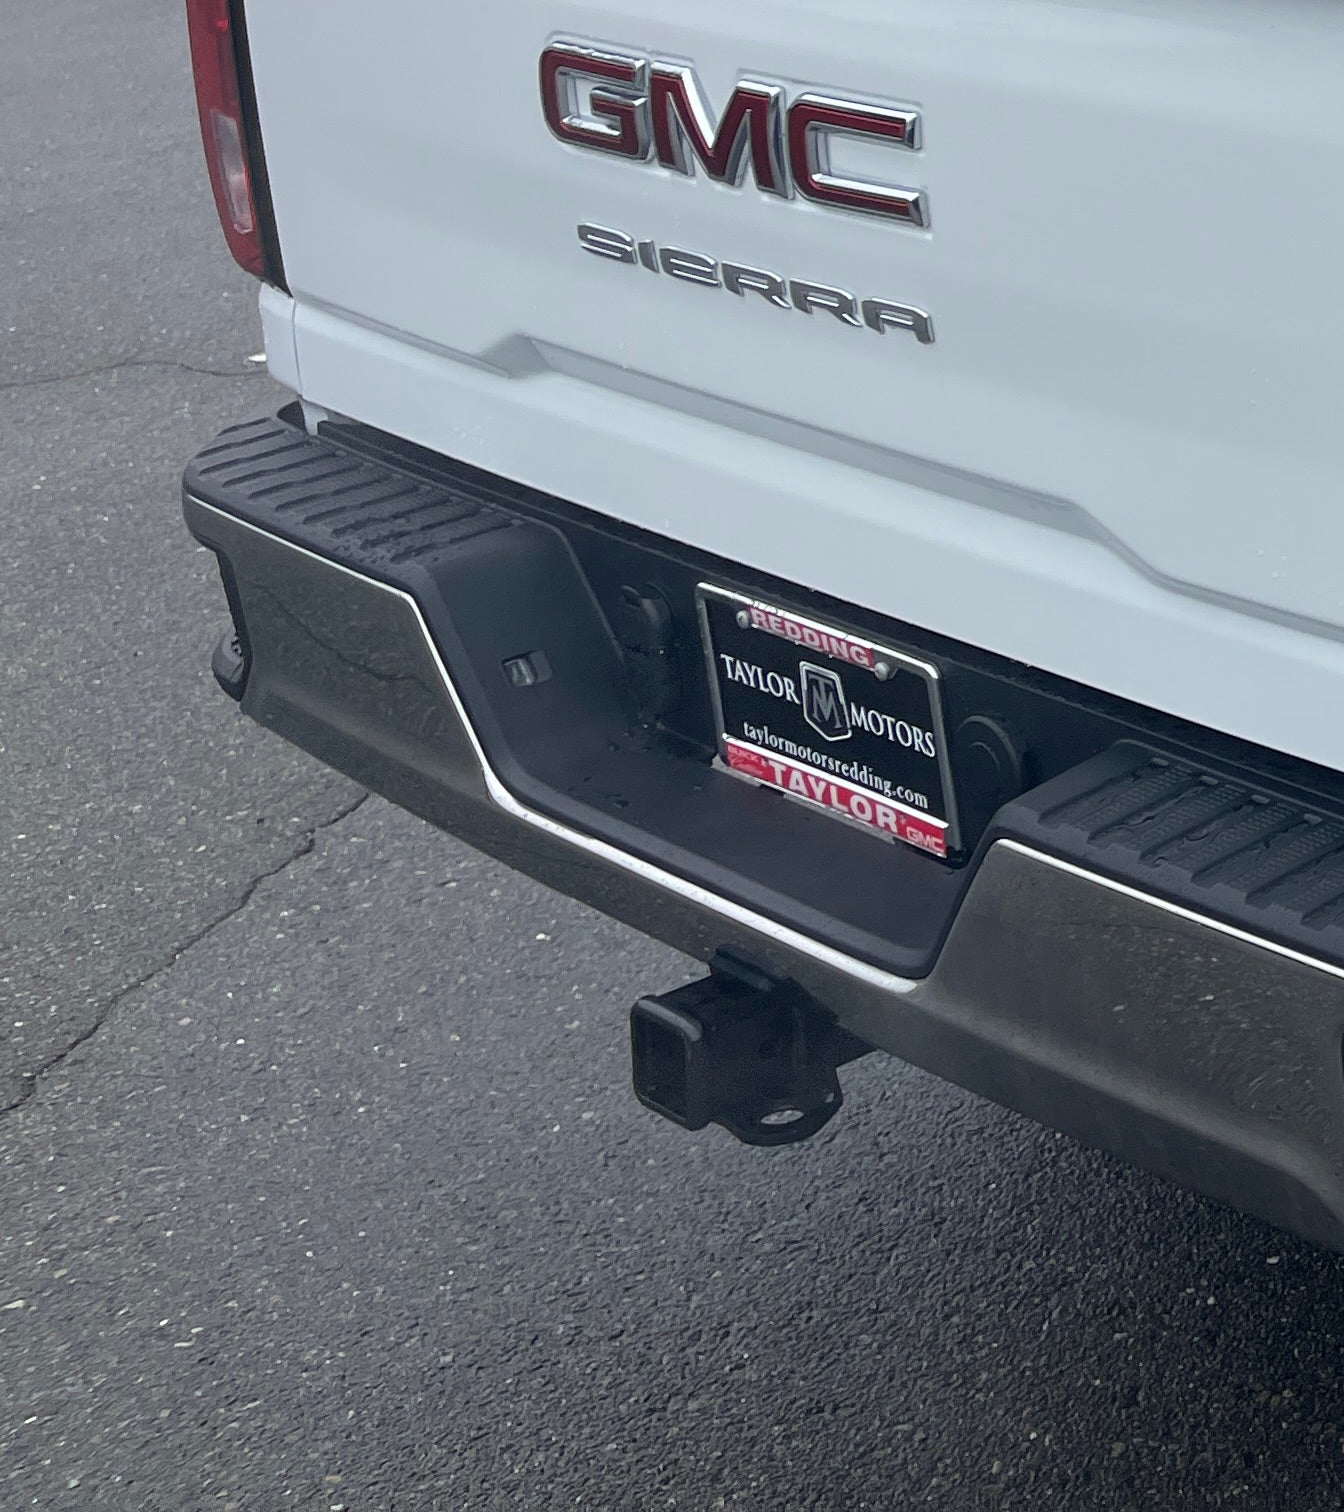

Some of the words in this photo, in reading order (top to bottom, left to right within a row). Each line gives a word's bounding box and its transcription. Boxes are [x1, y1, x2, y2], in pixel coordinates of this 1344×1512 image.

[540, 38, 932, 229] GMC
[576, 222, 936, 345] SIERRA
[749, 607, 871, 667] REDDING
[720, 653, 801, 705] TAYLOR
[850, 702, 937, 758] MOTORS
[743, 721, 928, 810] taylormotorsredding.com
[768, 759, 898, 833] TAYLOR
[906, 826, 944, 851] GMC
